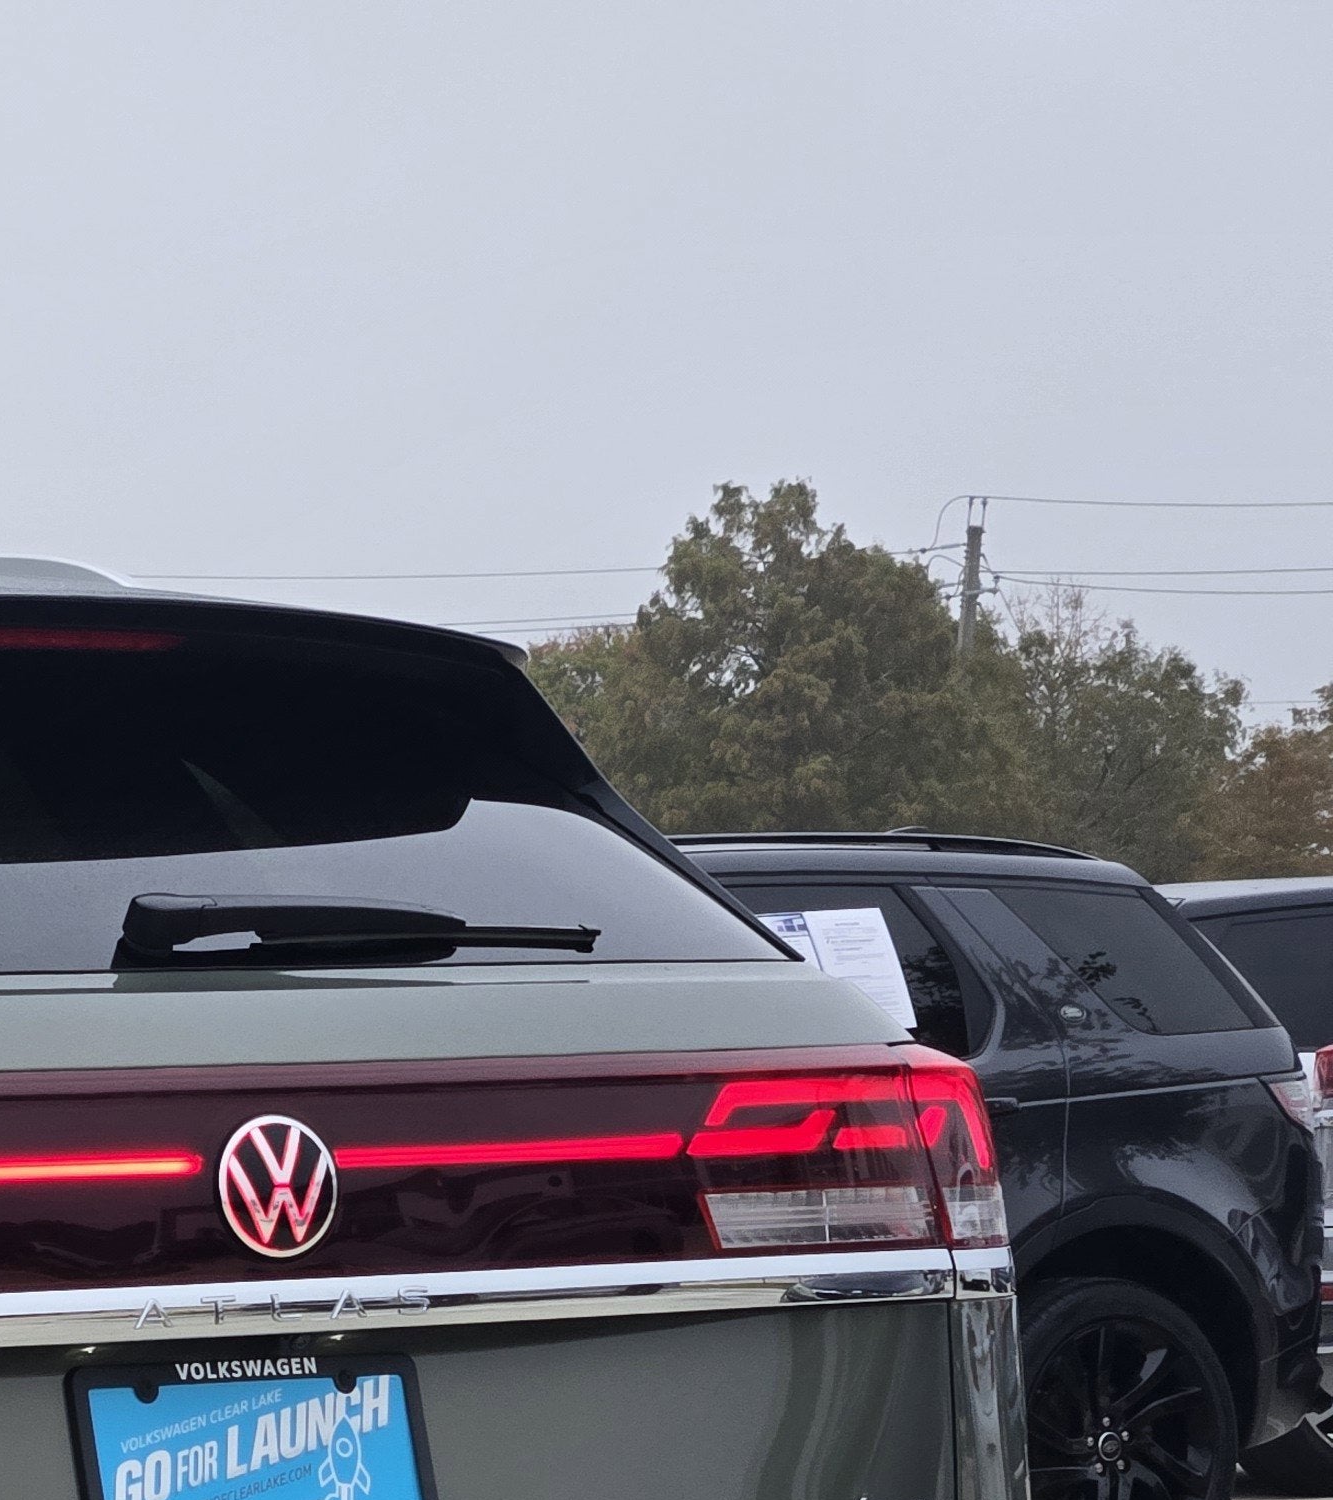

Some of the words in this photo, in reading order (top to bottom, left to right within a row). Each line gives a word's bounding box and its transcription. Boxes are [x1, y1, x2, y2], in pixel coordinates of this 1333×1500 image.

[133, 1285, 431, 1330] ATLAS
[175, 1357, 318, 1381] VOLKSWAGEN
[119, 1414, 208, 1453] VOLKSWAGEN
[210, 1401, 249, 1424] CLEAR
[252, 1388, 283, 1409] LAKE
[176, 1440, 219, 1492] FOR
[226, 1374, 391, 1480] LAUNCH
